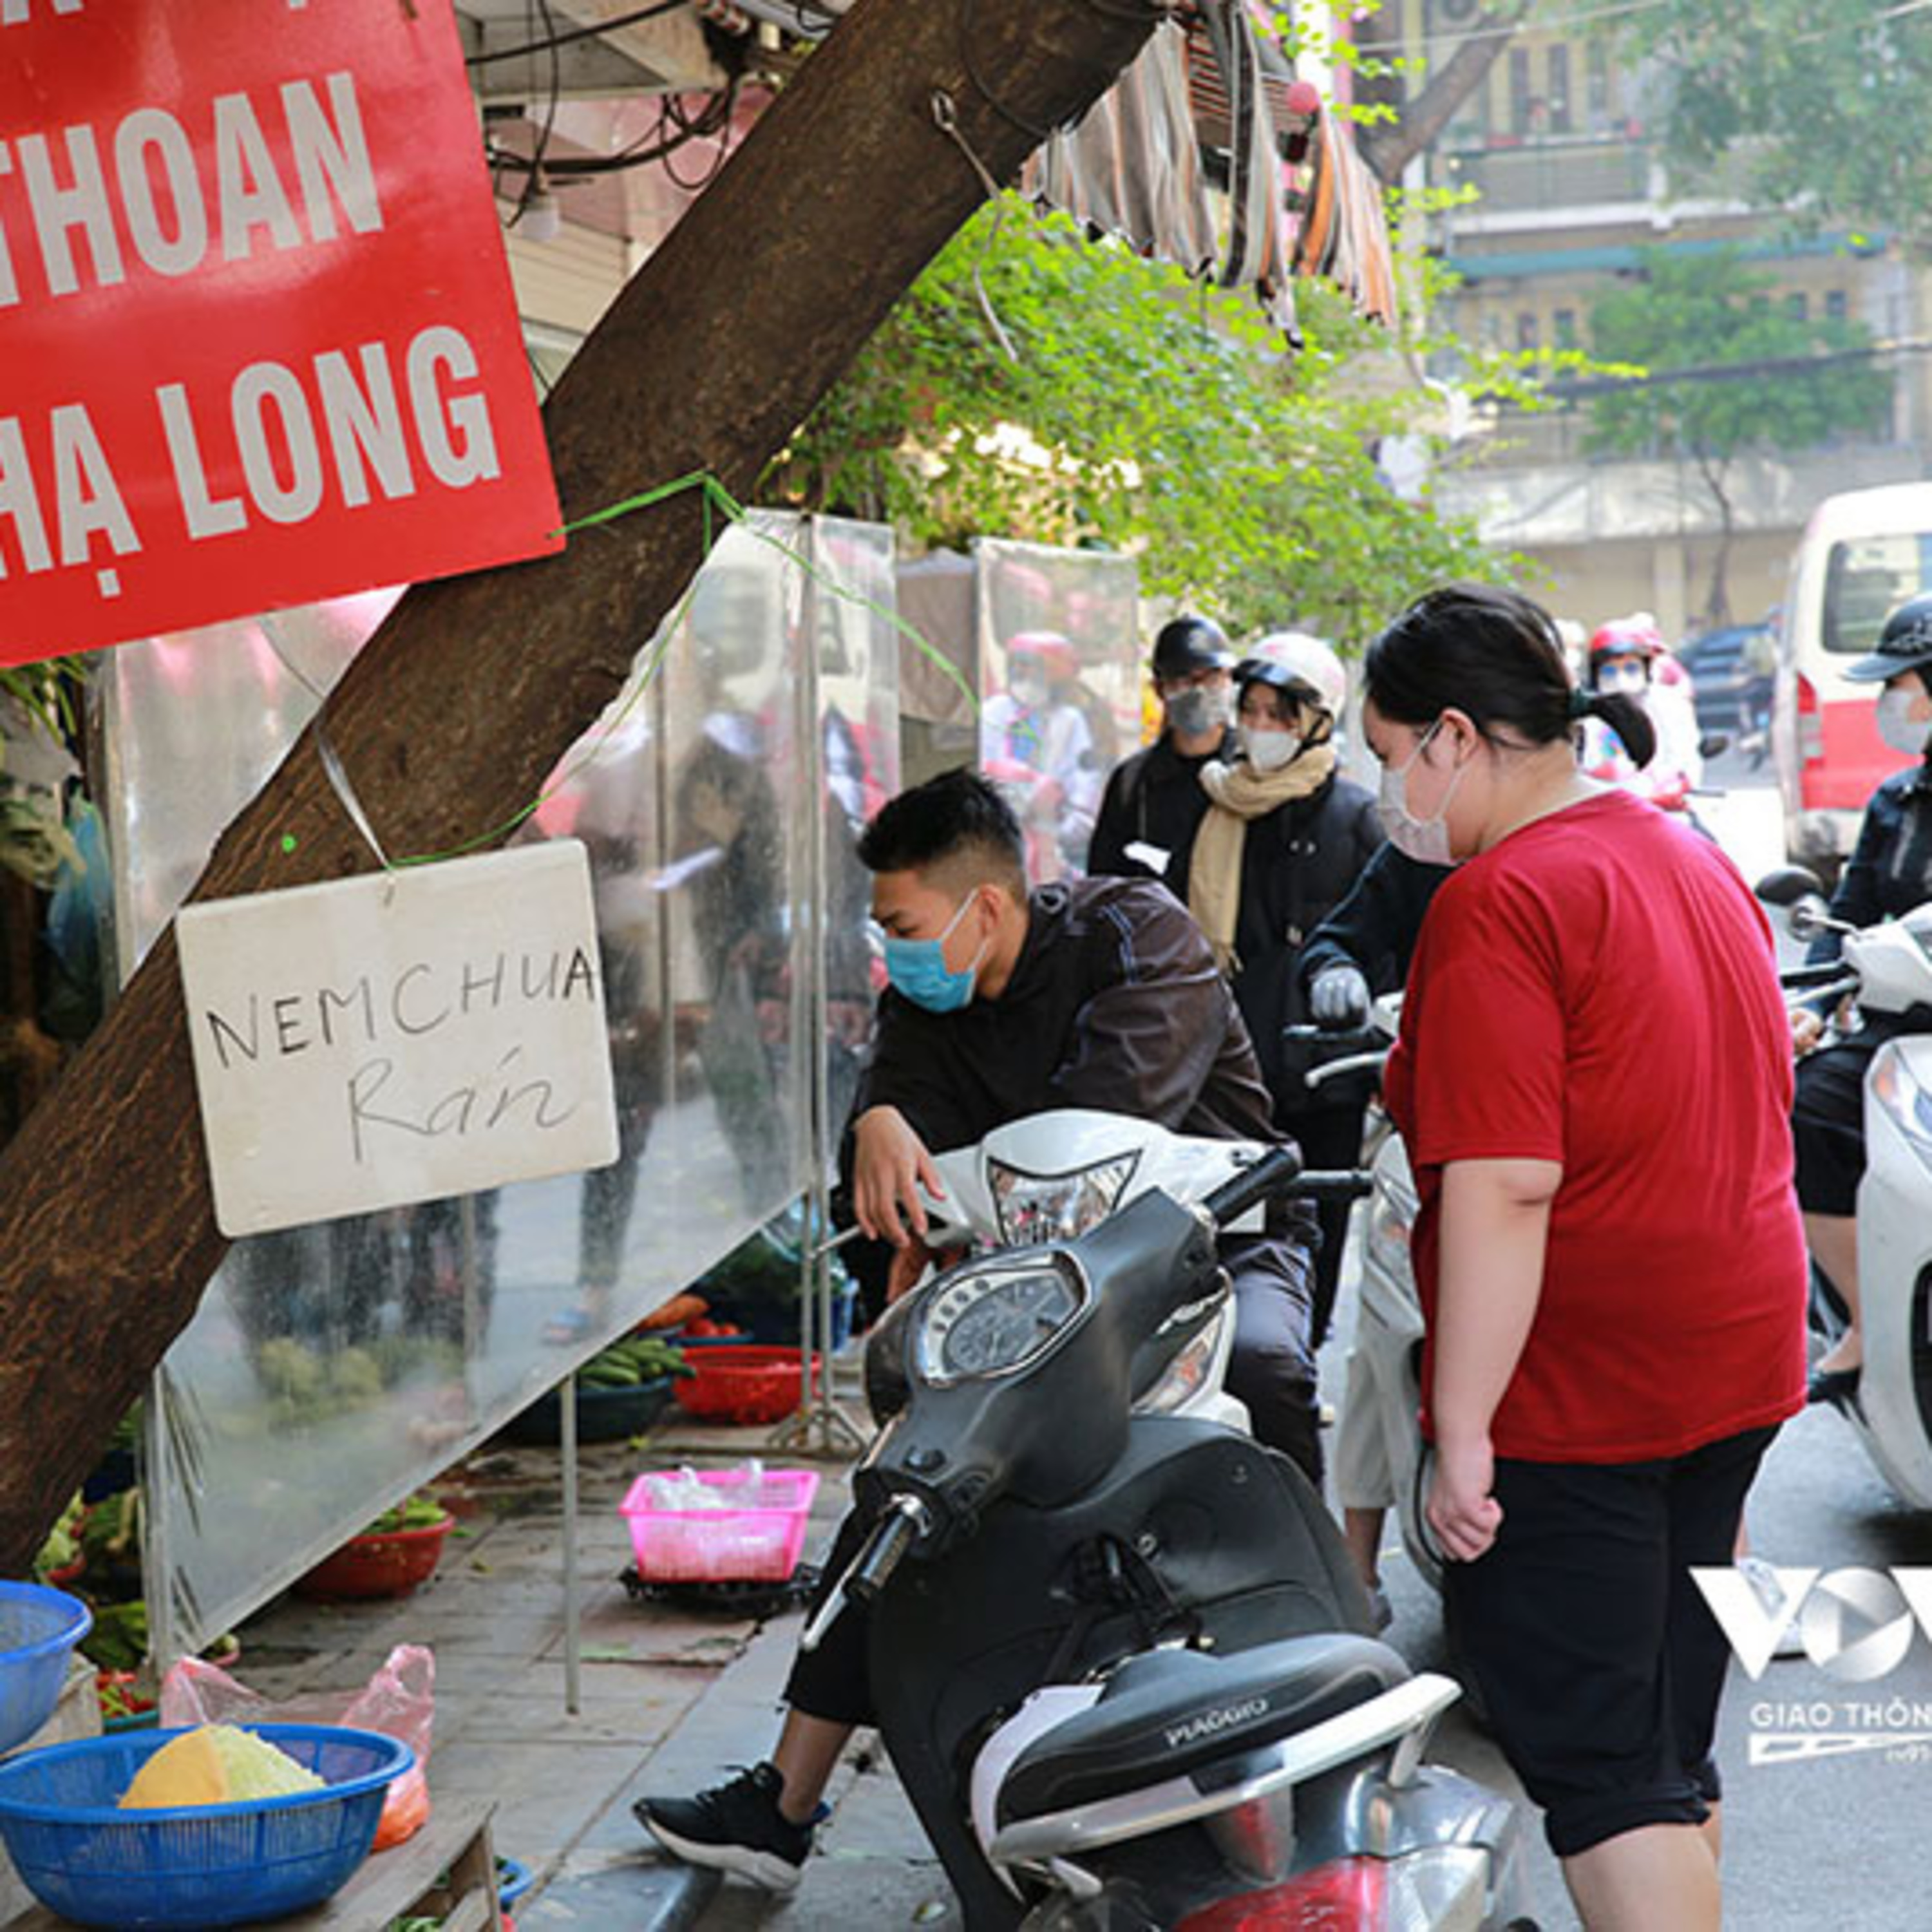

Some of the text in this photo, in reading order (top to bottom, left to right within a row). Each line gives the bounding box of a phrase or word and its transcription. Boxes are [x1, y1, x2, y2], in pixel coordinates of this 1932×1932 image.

[0, 70, 383, 307] HOAN
[156, 325, 501, 541] LONG
[348, 1045, 577, 1163] Rán
[1164, 1698, 1269, 1747] PIAGGIO
